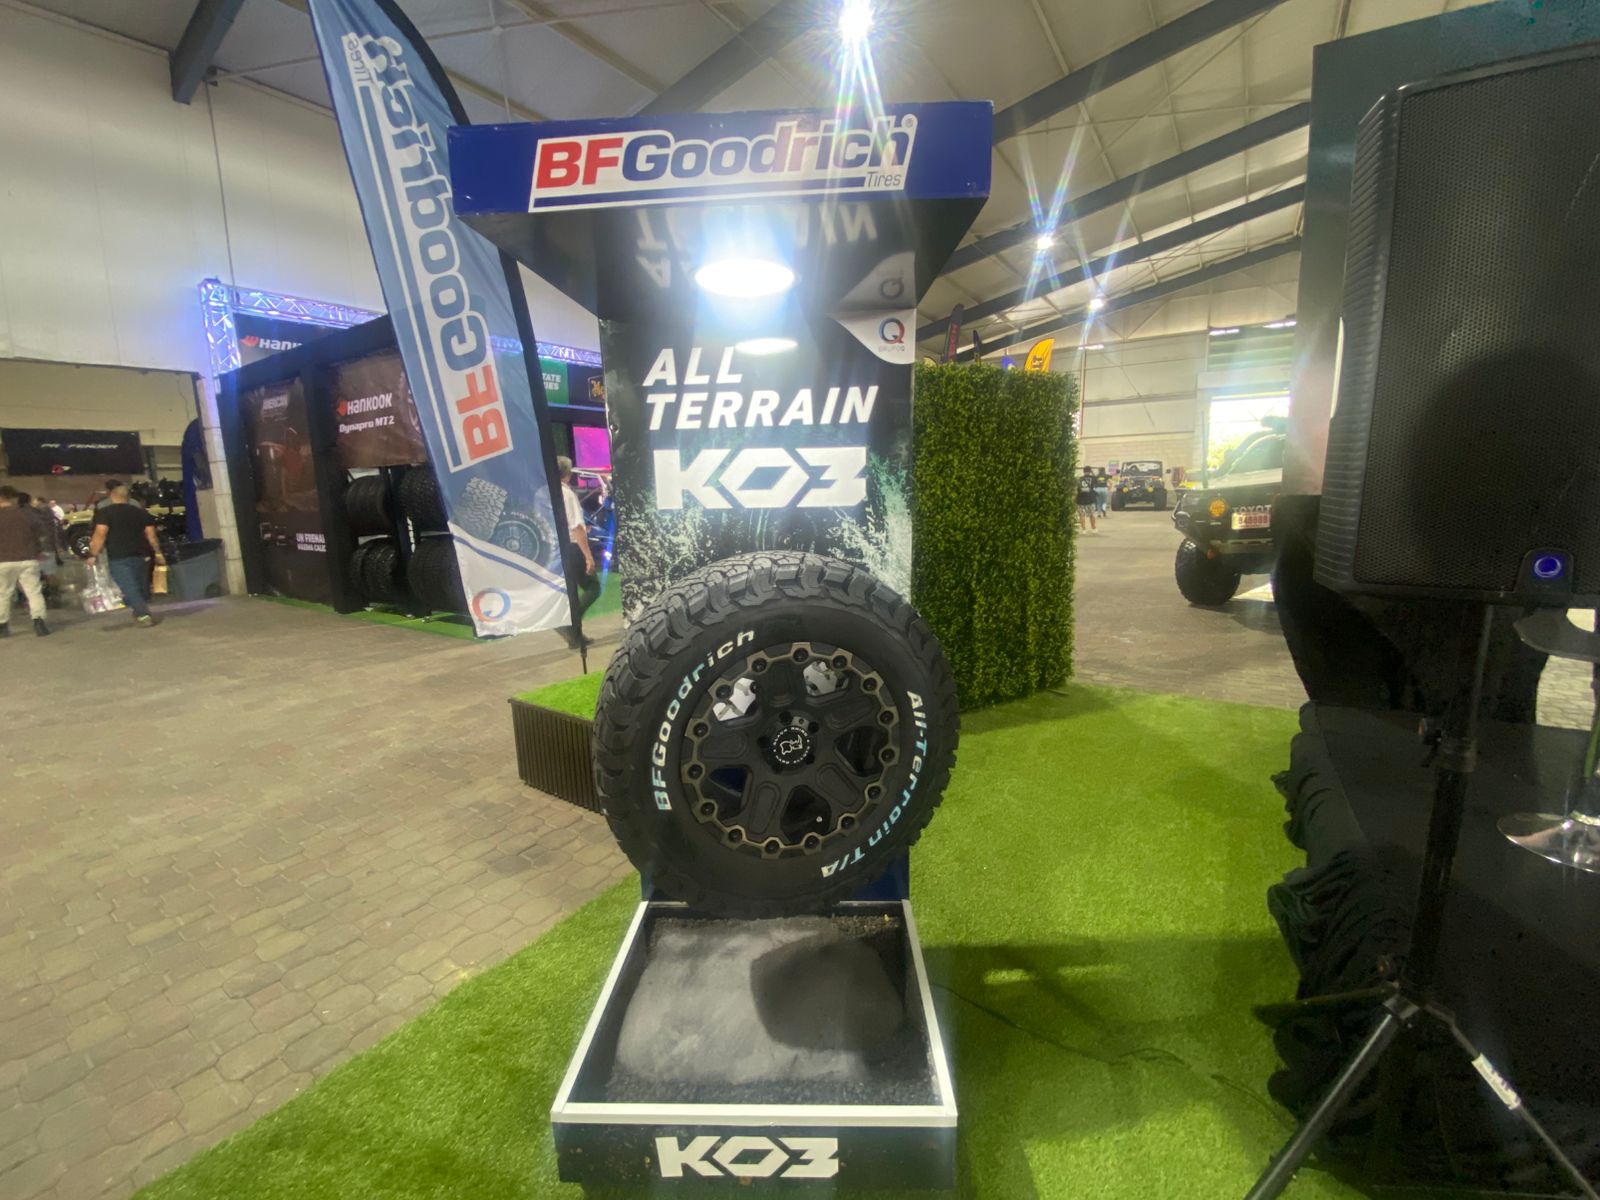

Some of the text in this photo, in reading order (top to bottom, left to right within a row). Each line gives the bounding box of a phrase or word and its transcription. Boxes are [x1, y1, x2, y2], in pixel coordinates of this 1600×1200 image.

[535, 118, 911, 190] BFGoodrich
[866, 171, 902, 189] Tires
[642, 346, 744, 387] ALL
[646, 385, 879, 431] TERRAIN
[653, 447, 867, 510] KO3
[652, 630, 755, 811] BFGoodrich
[655, 1135, 839, 1178] KO3
